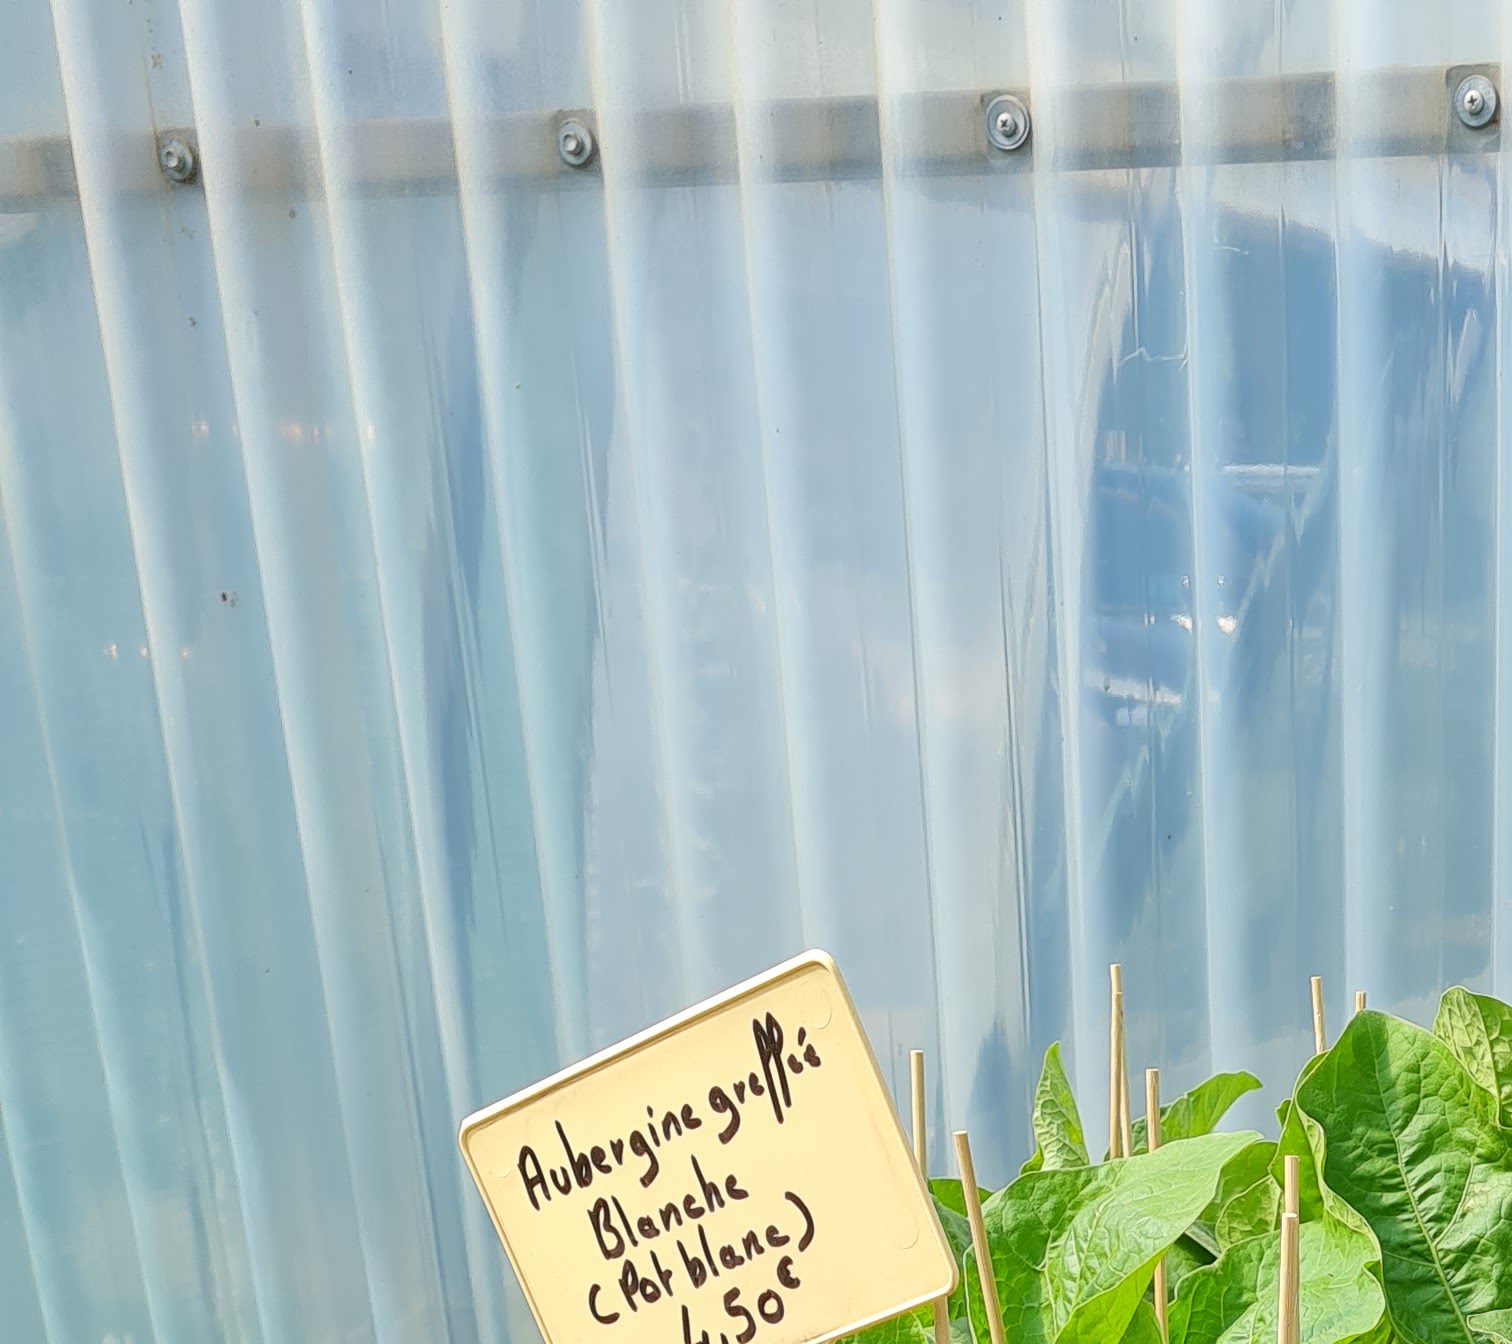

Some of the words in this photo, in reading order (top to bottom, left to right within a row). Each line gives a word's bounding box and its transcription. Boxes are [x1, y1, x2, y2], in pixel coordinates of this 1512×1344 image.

[517, 1104, 703, 1212] Aubergine
[587, 1153, 750, 1261] Blanche
[588, 1249, 674, 1325] (Pot
[676, 1191, 815, 1290] blanc)
